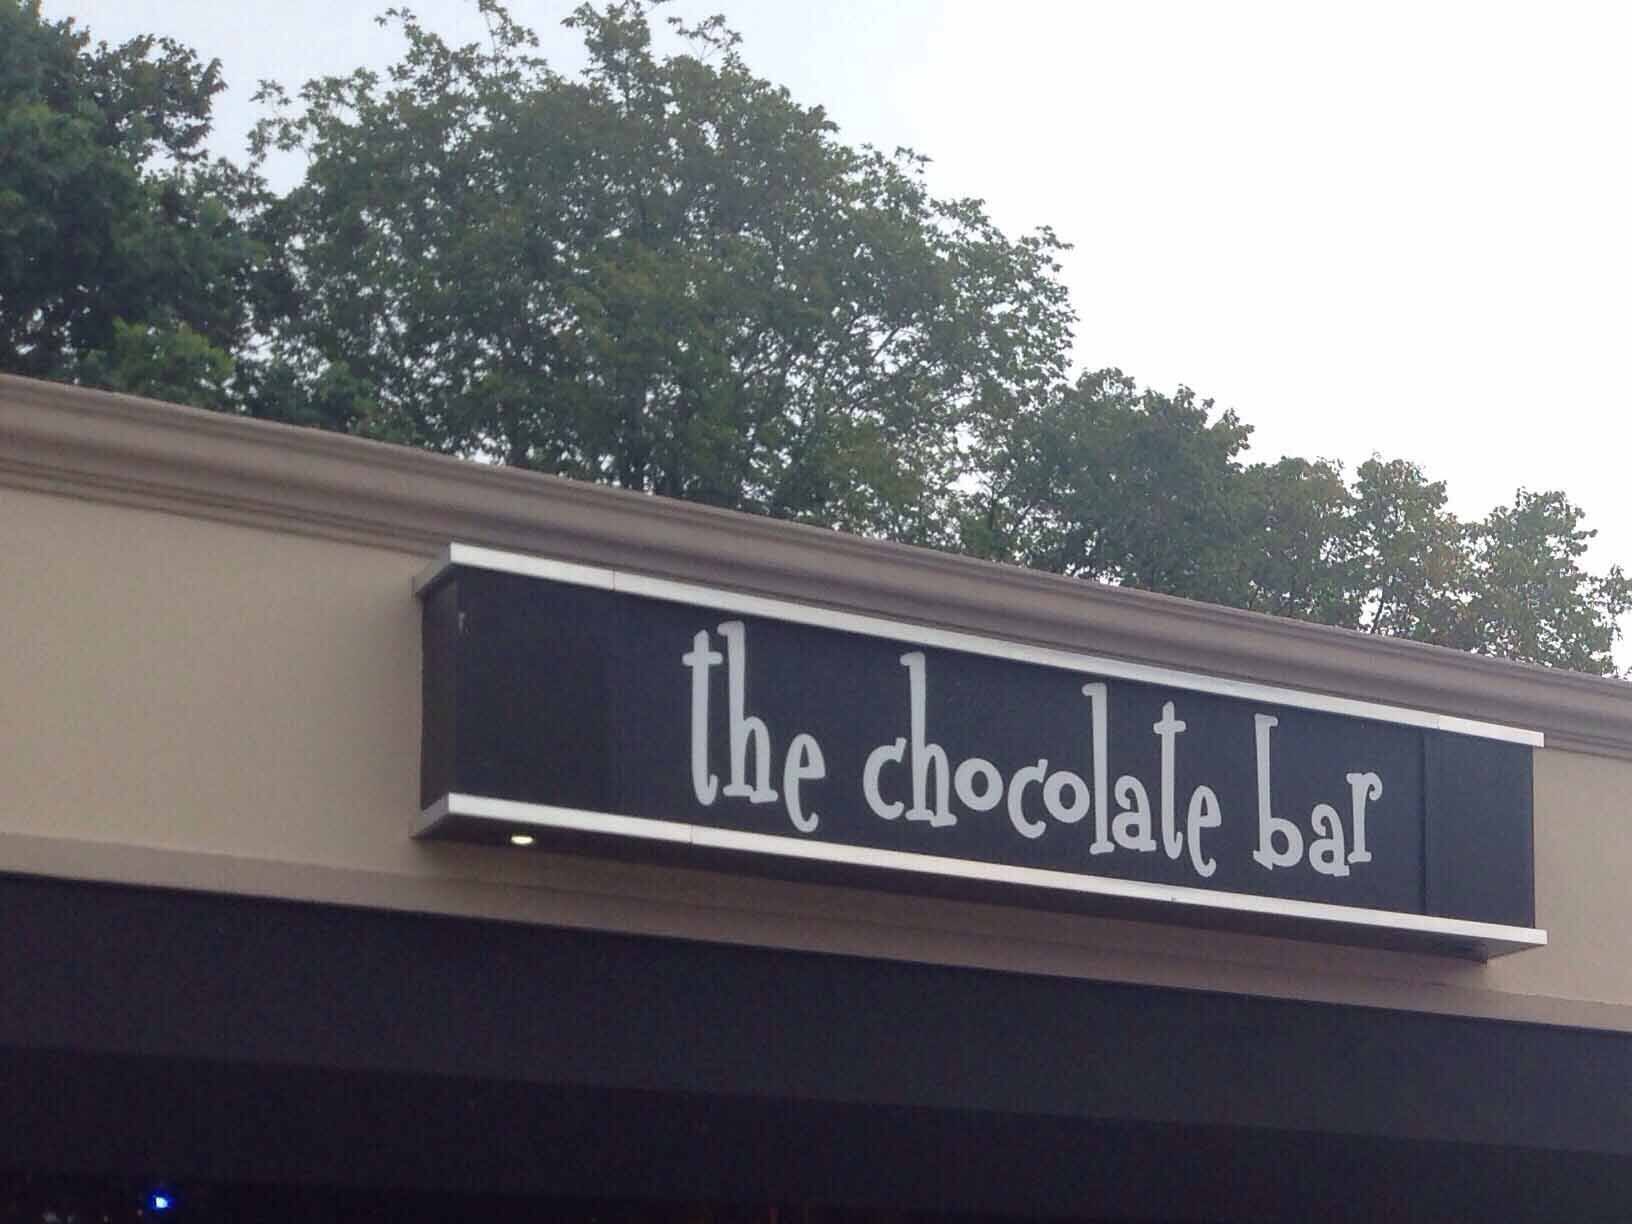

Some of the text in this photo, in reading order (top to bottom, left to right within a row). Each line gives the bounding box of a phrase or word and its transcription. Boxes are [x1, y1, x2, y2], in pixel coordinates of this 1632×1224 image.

[682, 621, 1381, 878] the chocolate bar
